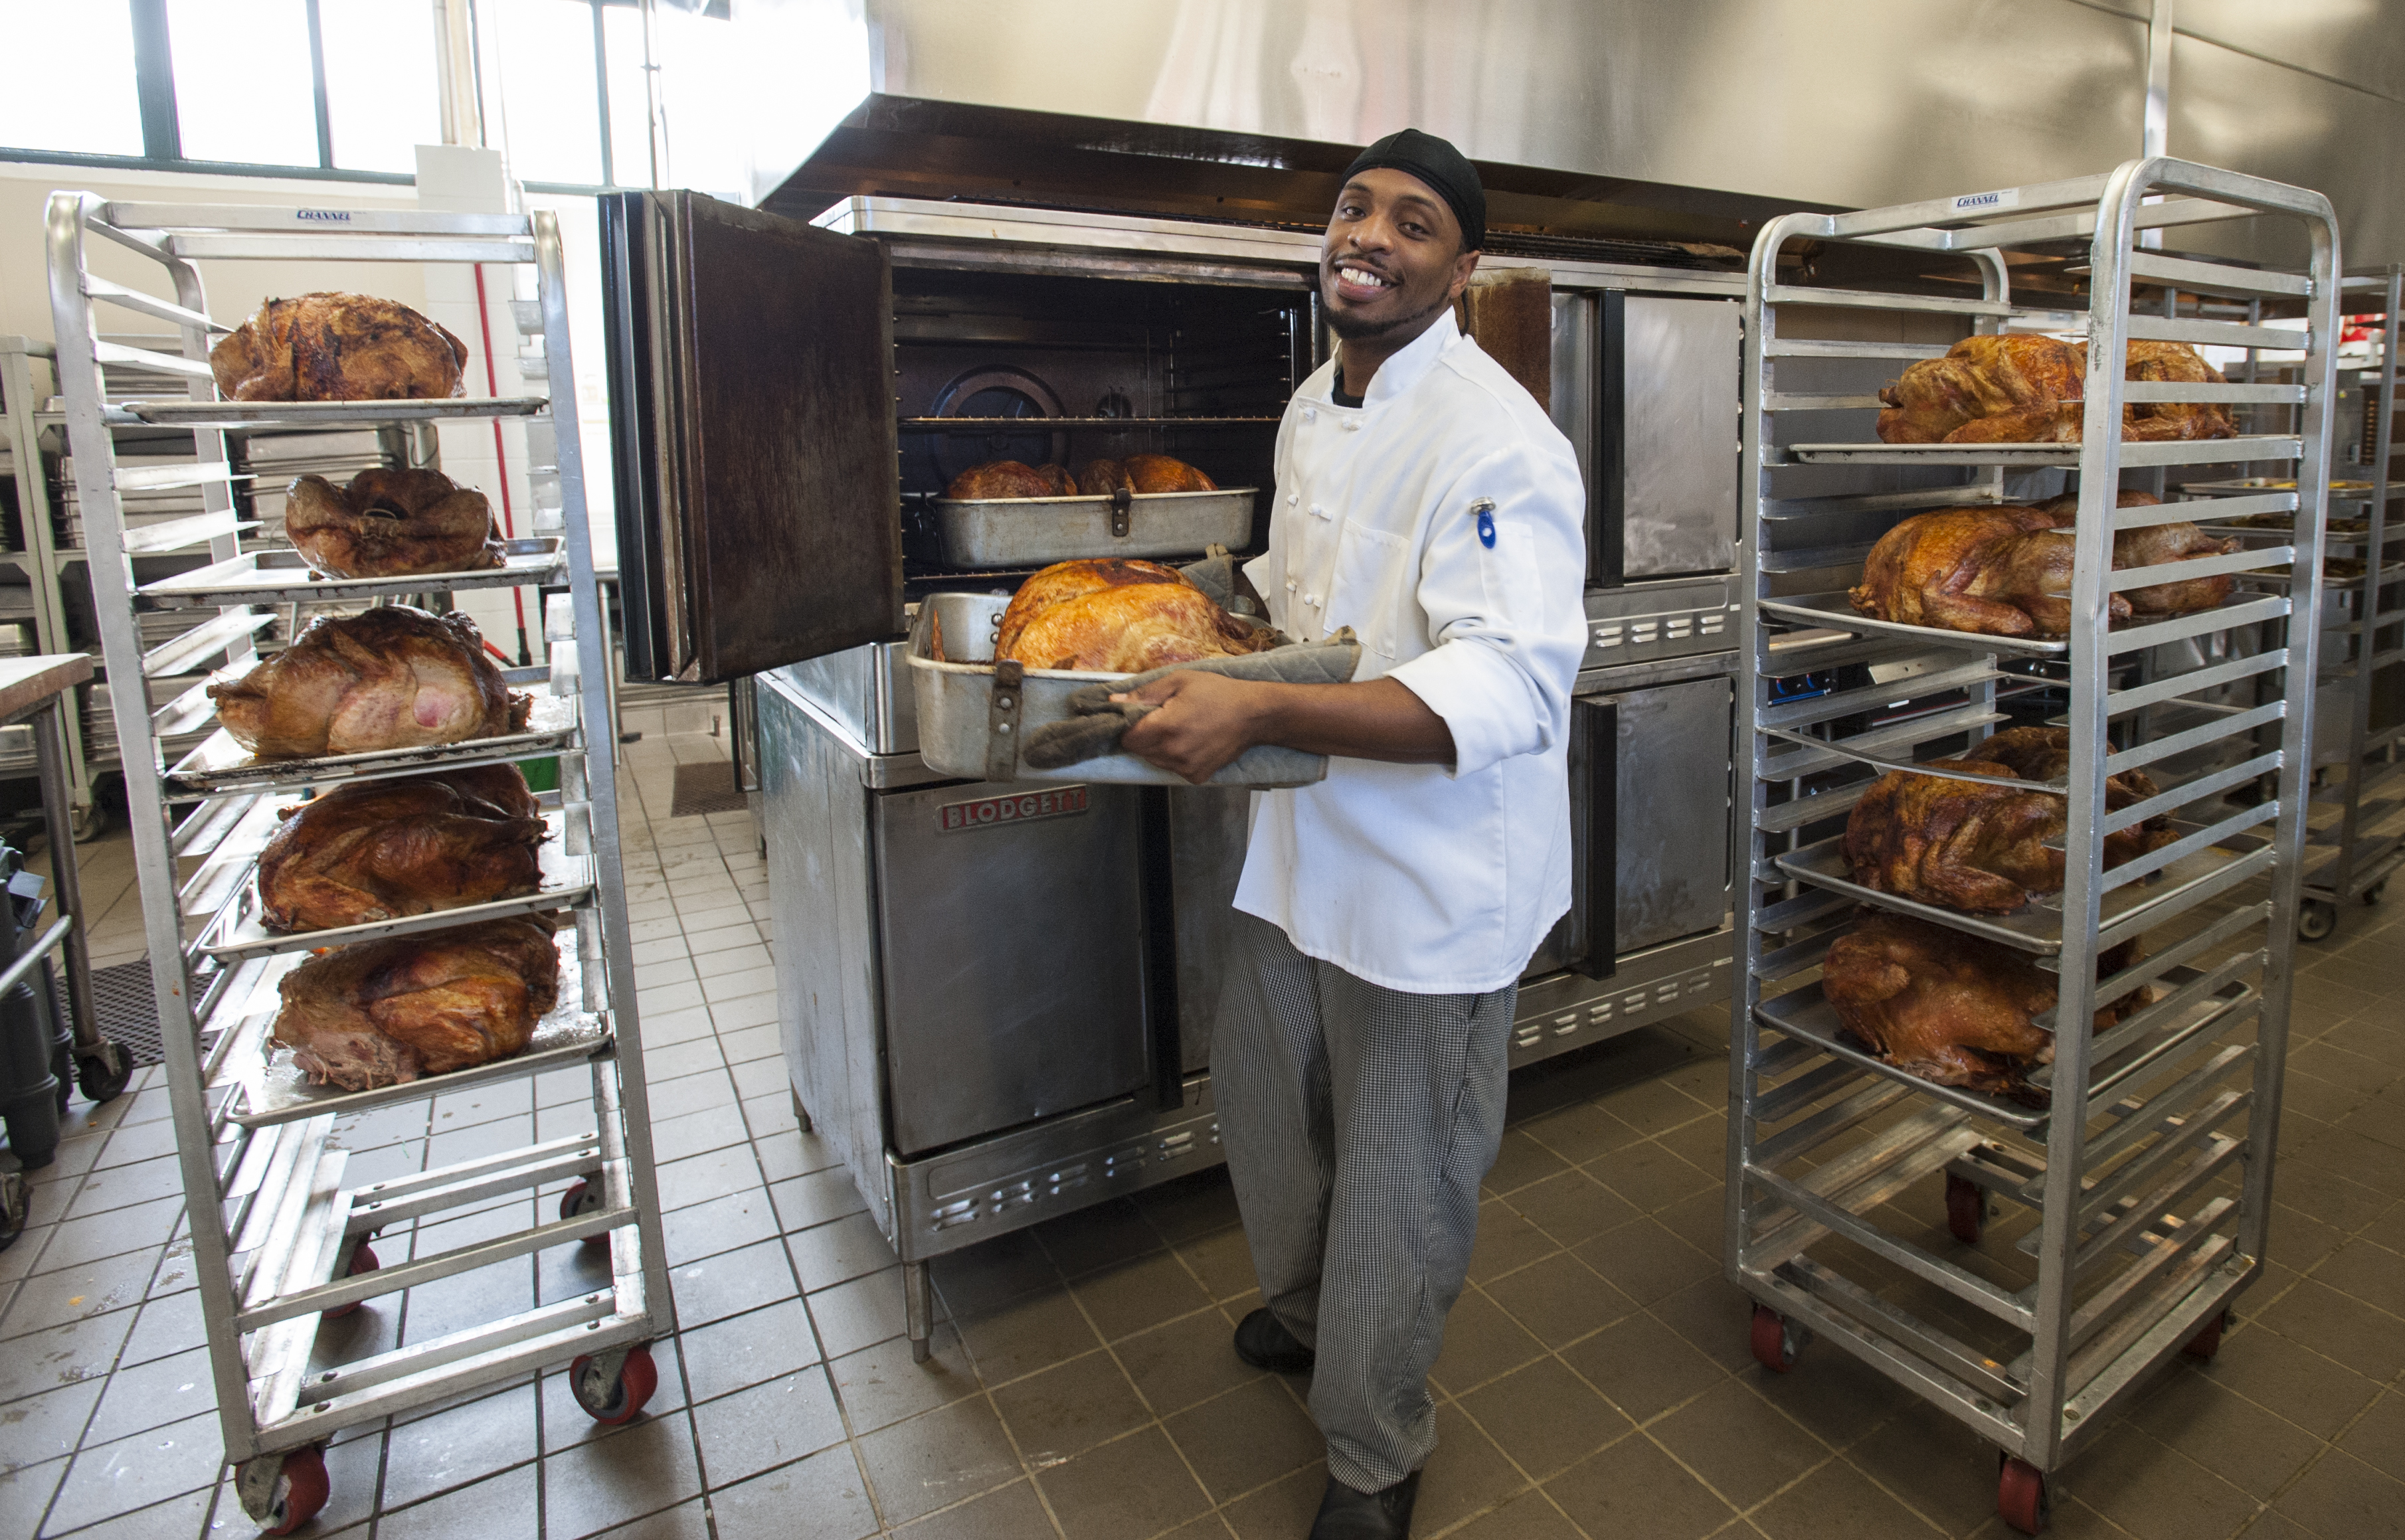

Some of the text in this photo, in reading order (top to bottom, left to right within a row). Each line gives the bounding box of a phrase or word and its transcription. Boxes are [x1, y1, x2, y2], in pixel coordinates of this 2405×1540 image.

[1957, 194, 1999, 207] CHANNEL
[297, 210, 350, 220] CHANNEL
[947, 790, 1081, 828] BLODGETT
